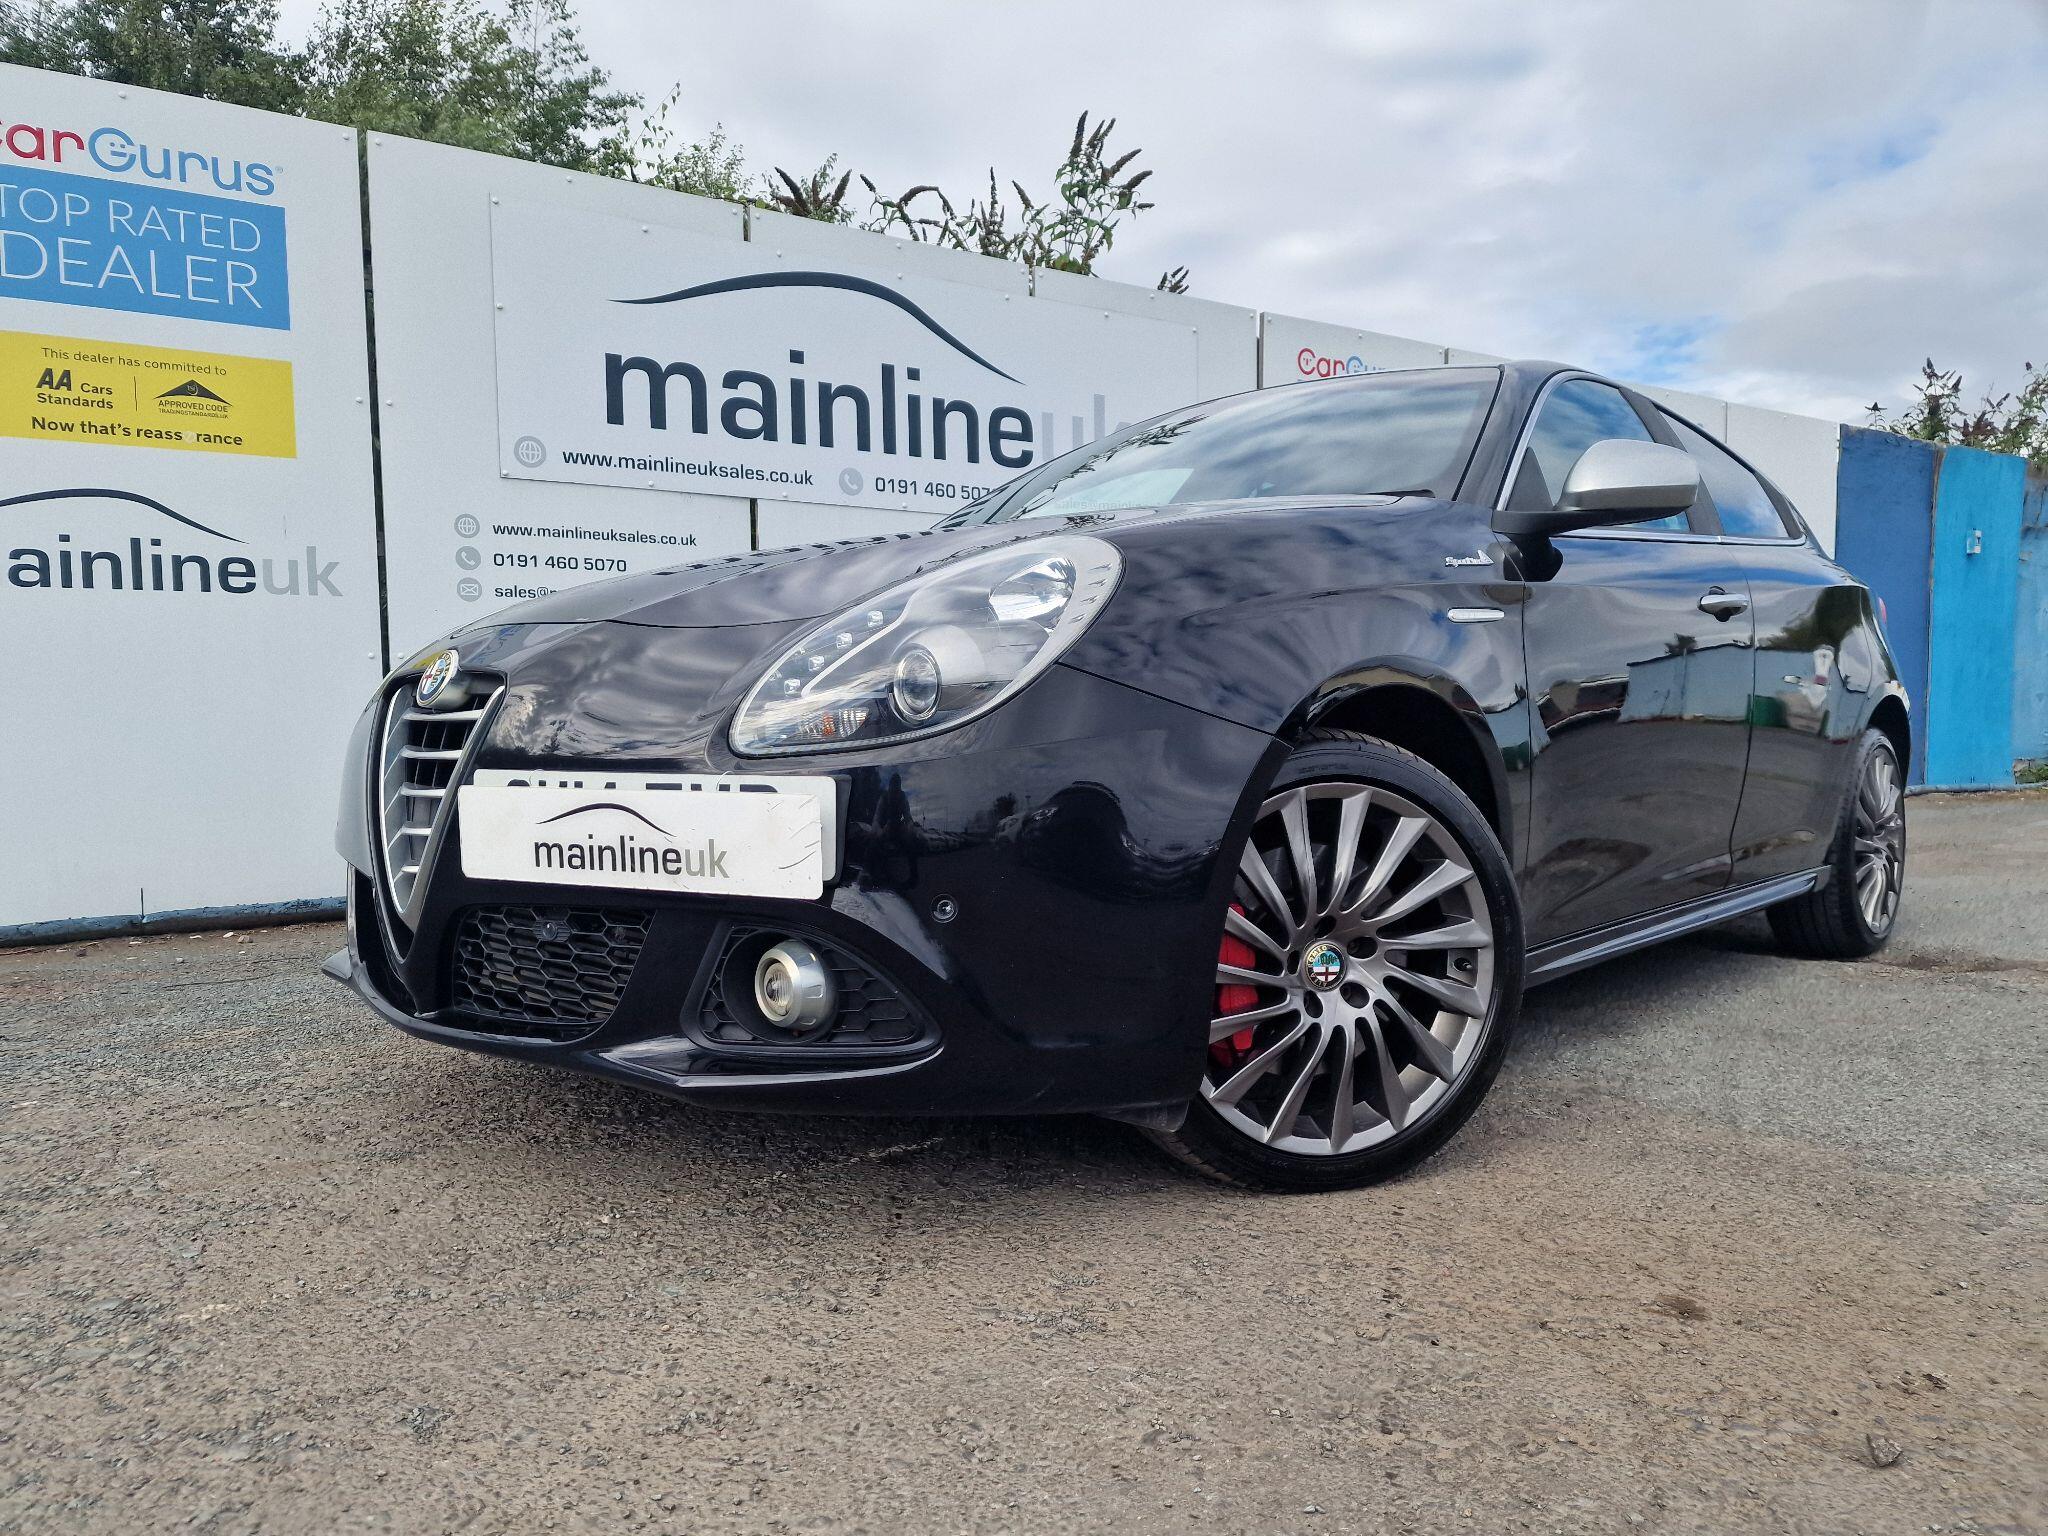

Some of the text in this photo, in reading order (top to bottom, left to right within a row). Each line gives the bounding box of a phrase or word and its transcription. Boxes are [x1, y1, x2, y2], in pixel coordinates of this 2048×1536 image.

[0, 120, 275, 196] arGurus
[0, 183, 261, 253] TOP RATED
[0, 229, 262, 309] DEALER
[41, 347, 227, 376] This dealer has committed to
[36, 367, 113, 395] AA Cars
[37, 392, 114, 410] Standards
[158, 400, 229, 413] APPROVED CODE
[31, 416, 75, 433] Now
[136, 427, 243, 446] reassrance
[562, 450, 814, 486] www.mainlineuksales.co.uk
[875, 477, 918, 496] 0191
[923, 482, 956, 499] 460
[492, 522, 698, 547] www.mainlineuksales.co.uk
[493, 553, 628, 573] 0191 460 5070
[534, 834, 730, 879] mainlineuk
